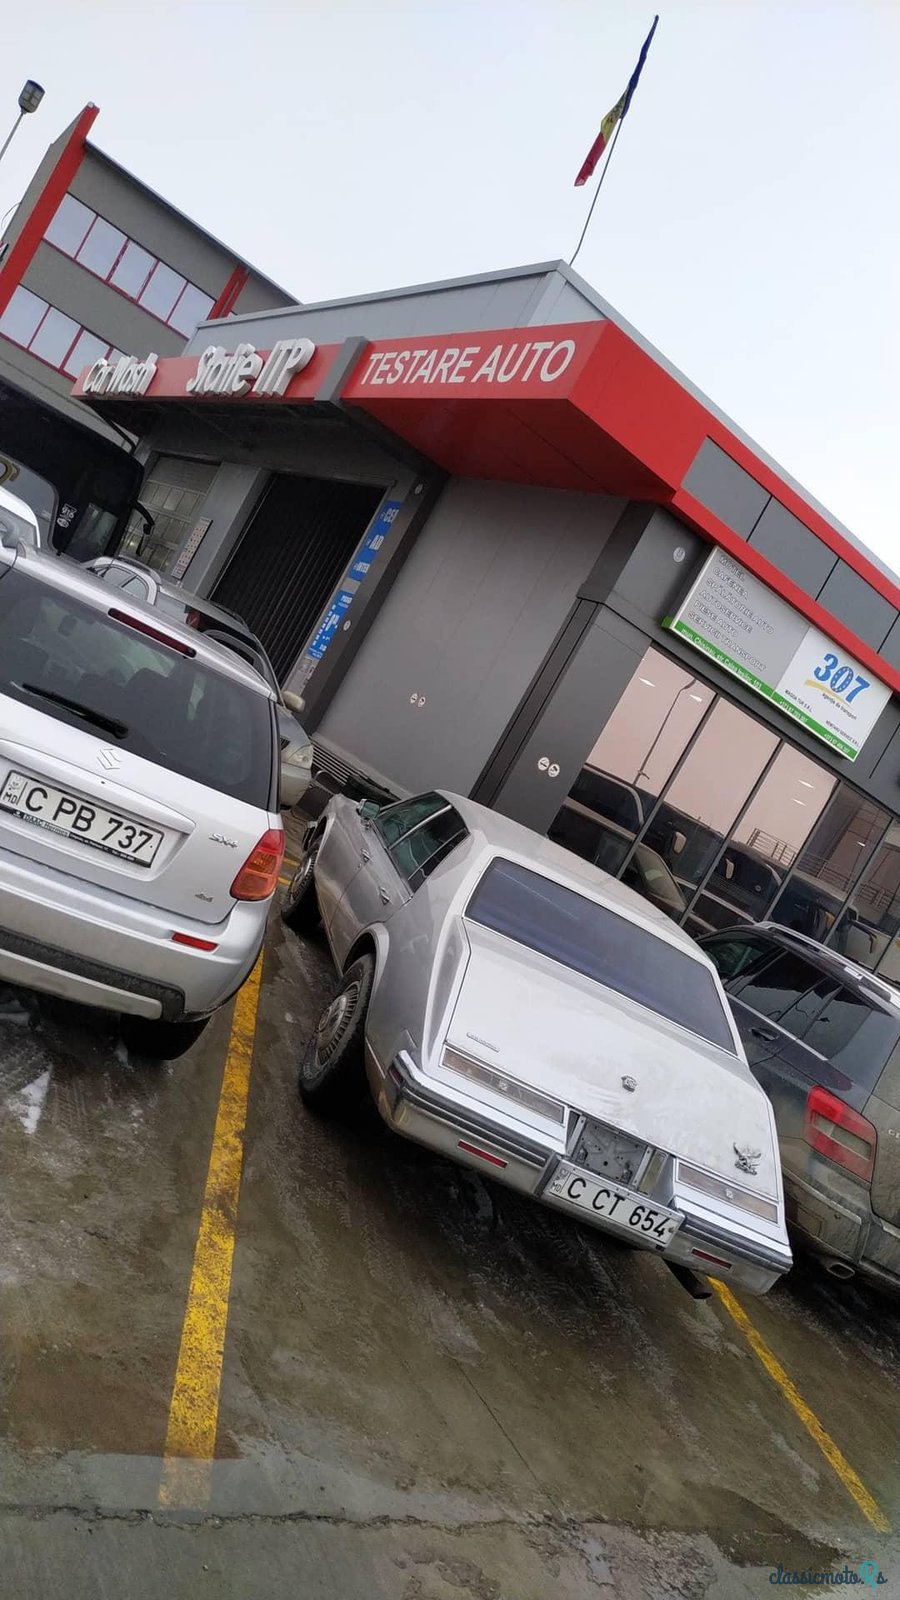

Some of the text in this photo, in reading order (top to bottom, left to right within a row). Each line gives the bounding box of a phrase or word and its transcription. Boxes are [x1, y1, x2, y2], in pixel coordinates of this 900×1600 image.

[82, 353, 158, 396] Car Wash
[252, 338, 316, 397] ITP
[361, 339, 576, 386] TESTARE AUTO
[713, 567, 749, 600] CAFENEA
[700, 589, 753, 634] AUTOSERVICE
[716, 617, 739, 638] AUTO
[751, 613, 775, 635] AUTO
[720, 634, 767, 671] TRANSPORT
[814, 653, 871, 703] 307
[3, 791, 18, 804] MD
[25, 787, 48, 812] C
[52, 797, 96, 832] PB
[101, 817, 153, 853] 737
[552, 1182, 562, 1193] MD
[567, 1178, 671, 1238] C CT 654
